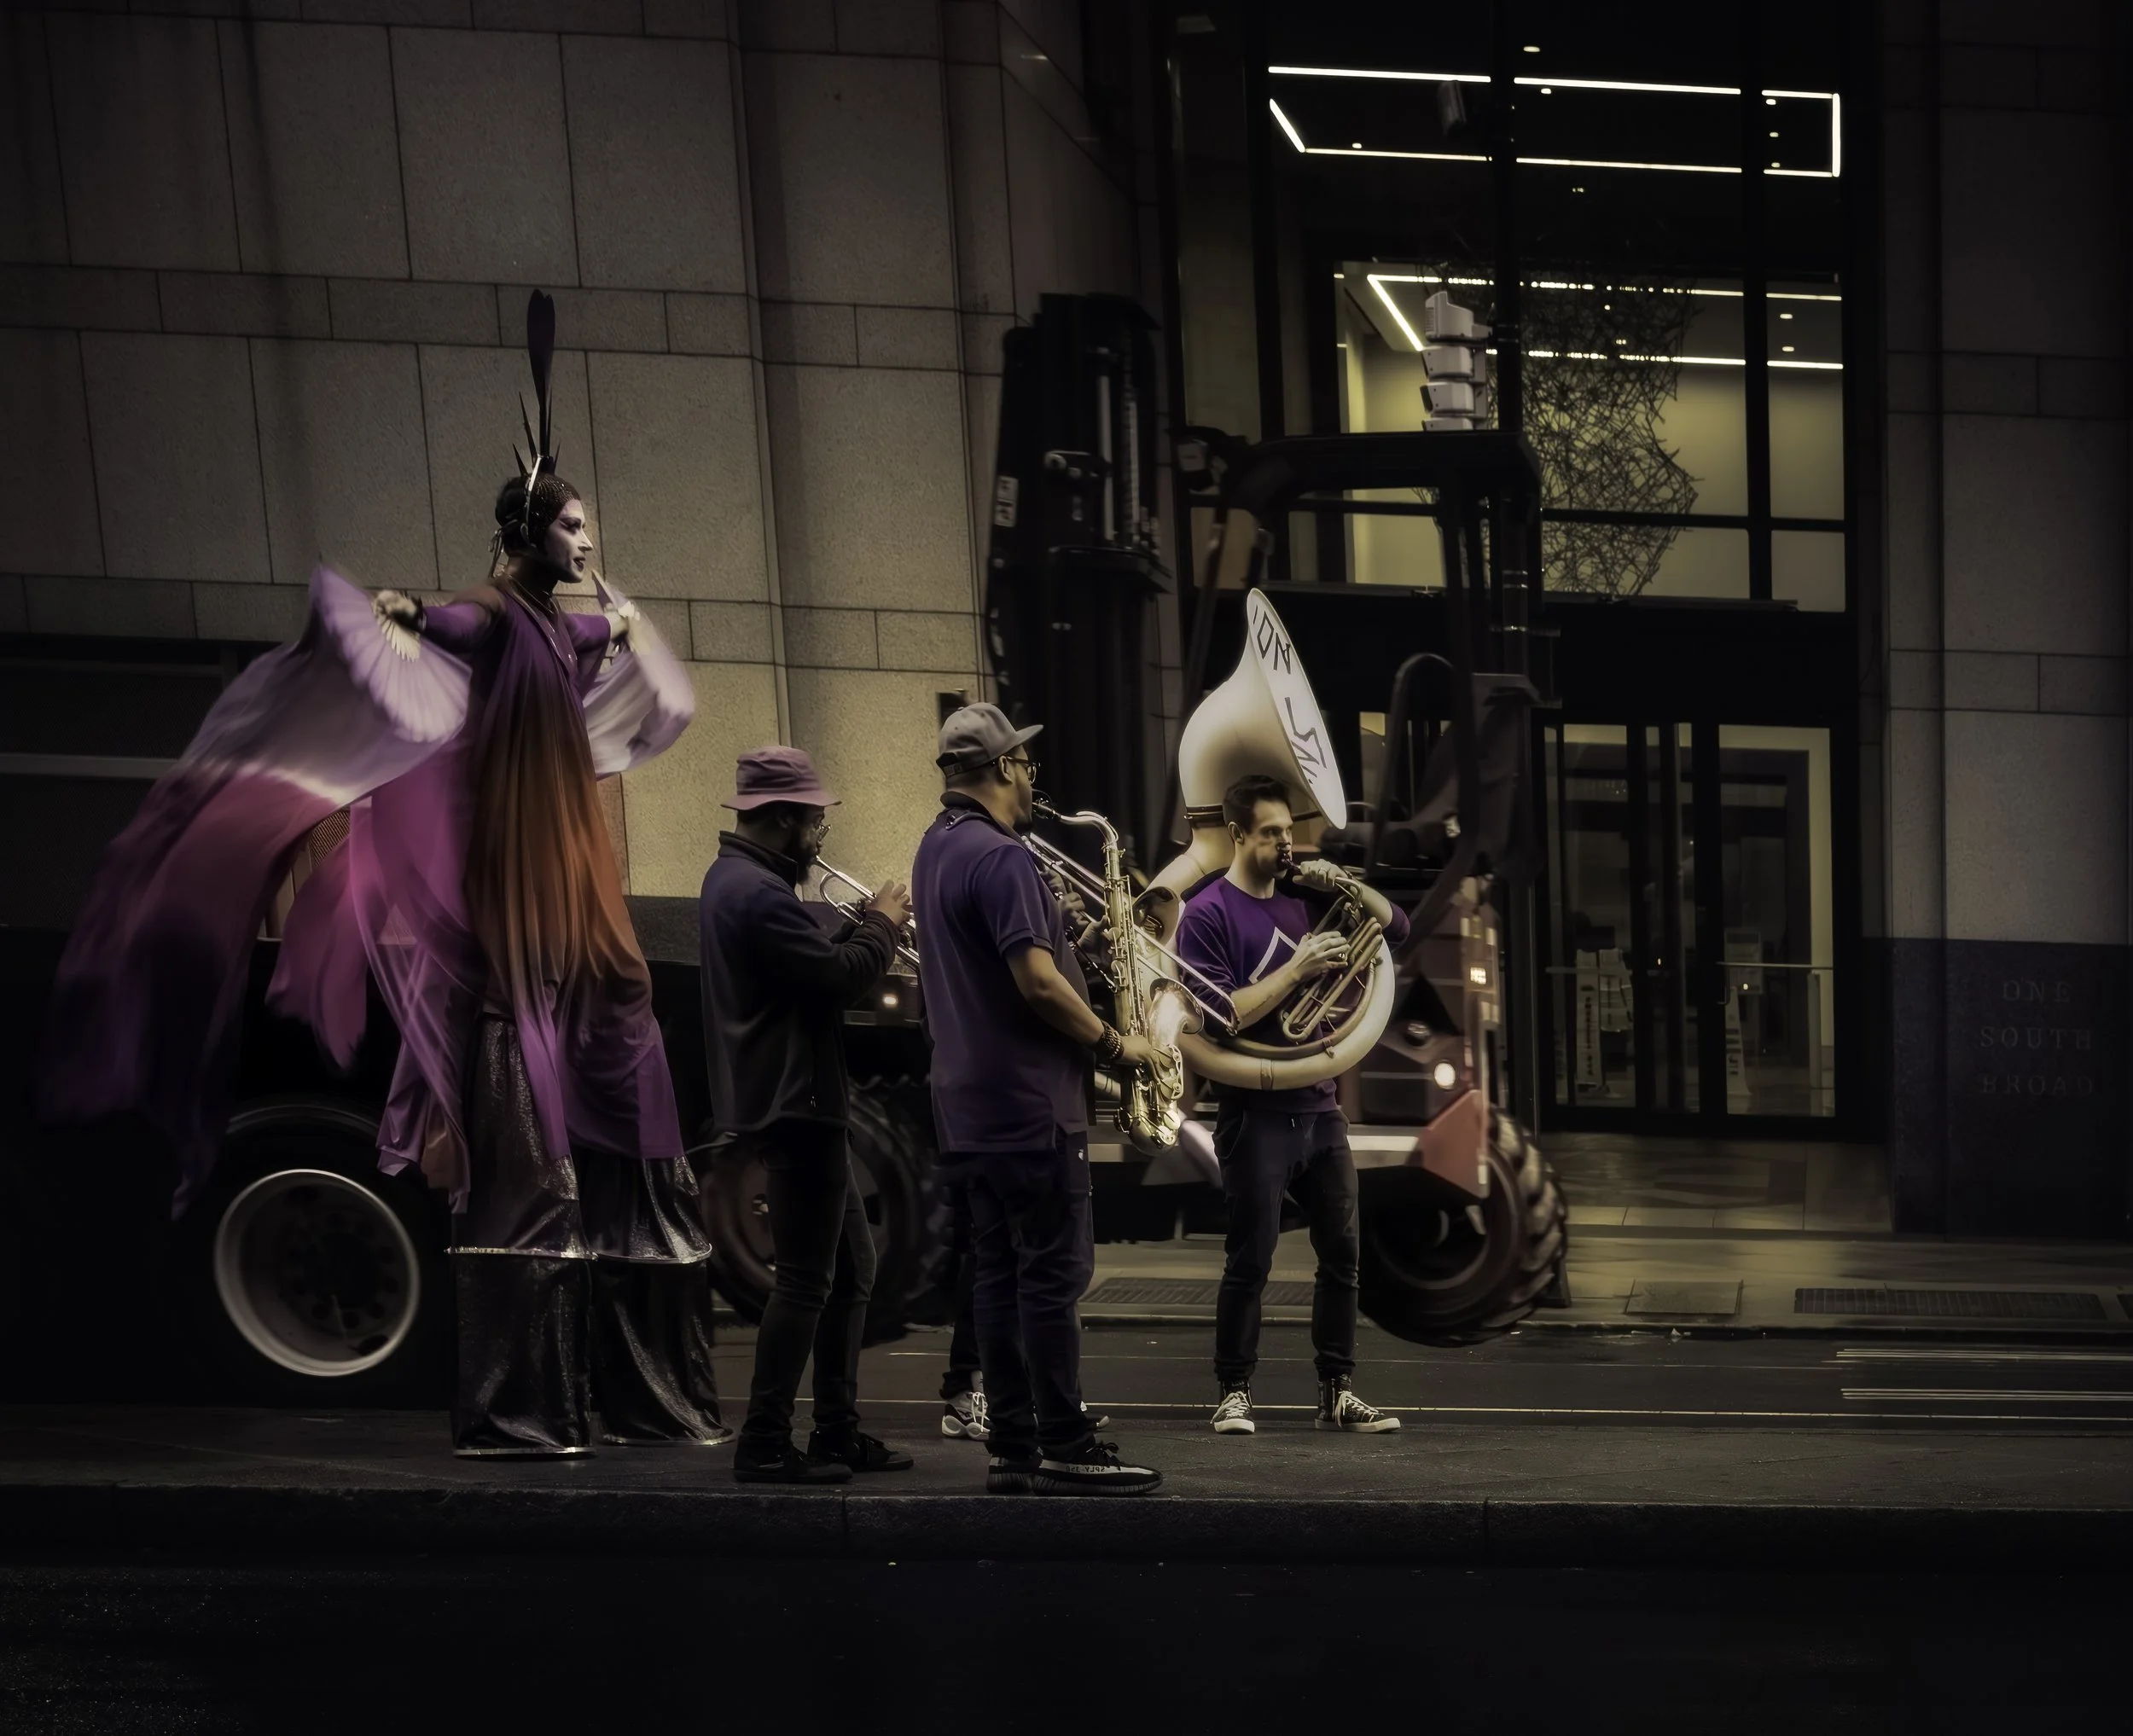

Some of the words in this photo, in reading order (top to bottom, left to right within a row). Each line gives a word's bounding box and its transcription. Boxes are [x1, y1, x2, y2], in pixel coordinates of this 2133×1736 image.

[2002, 980, 2073, 1003] ONE
[1979, 1025, 2092, 1050] SOUTH
[1980, 1074, 2093, 1096] BROAD
